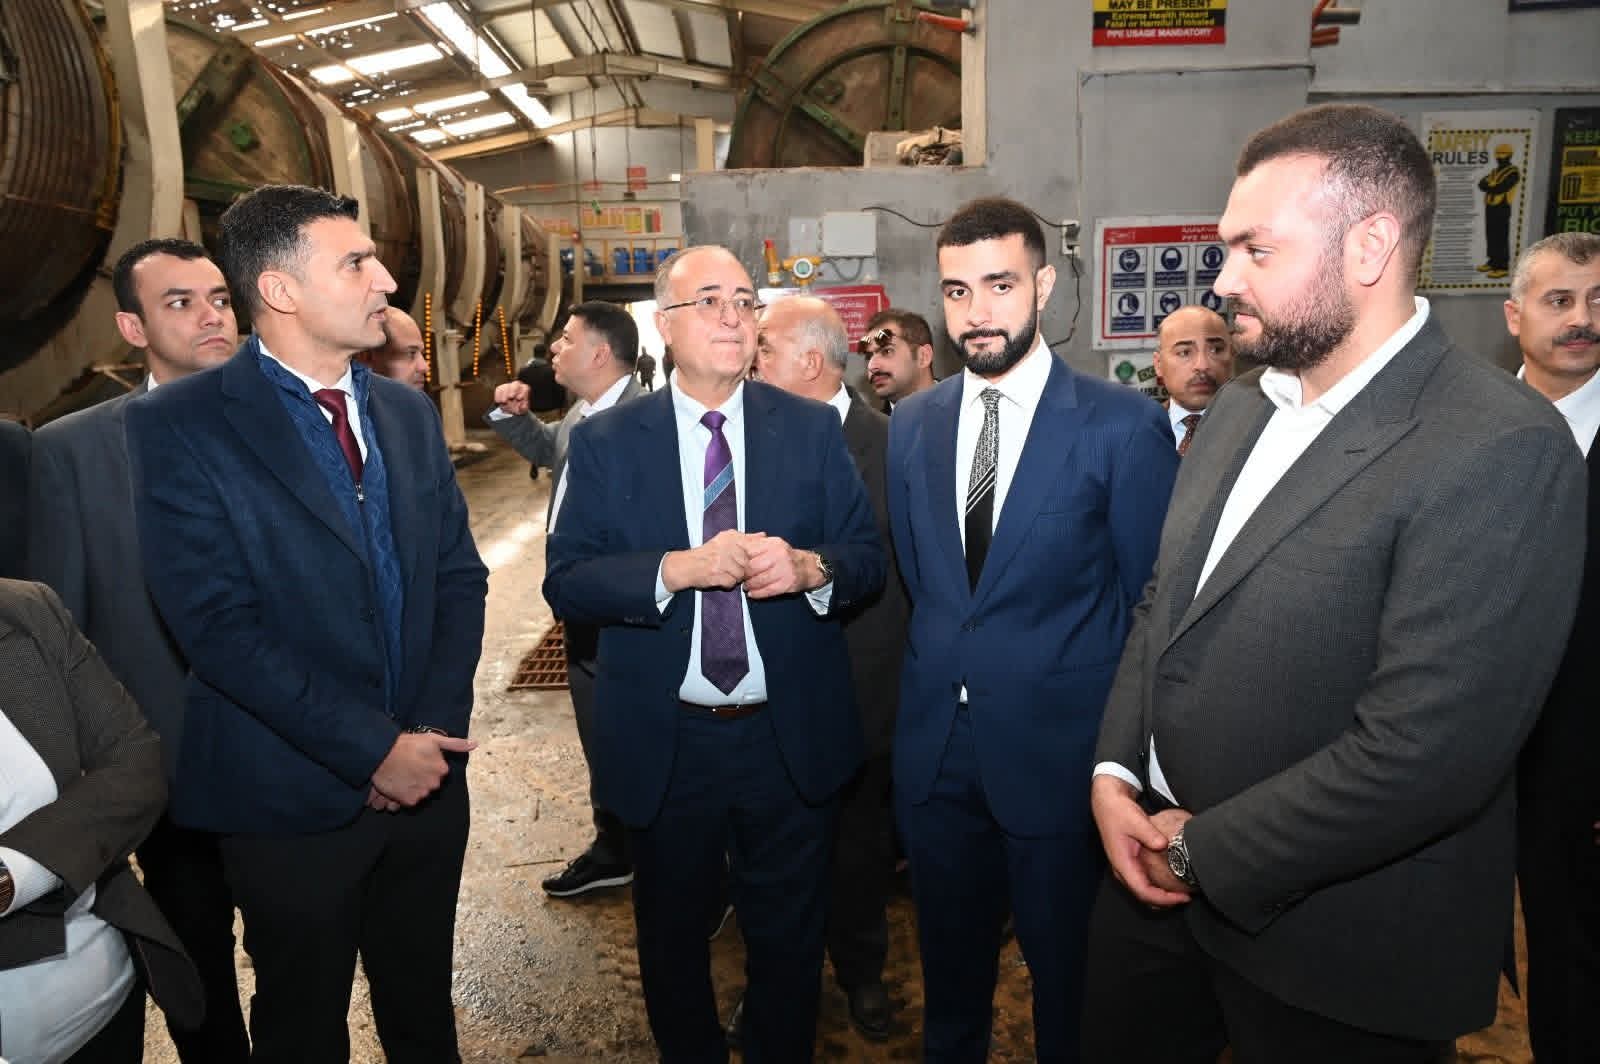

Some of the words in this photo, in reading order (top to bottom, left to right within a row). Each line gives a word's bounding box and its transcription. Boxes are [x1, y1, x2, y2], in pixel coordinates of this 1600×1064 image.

[1108, 0, 1132, 9] MAY
[1137, 0, 1153, 8] BE
[1157, 0, 1212, 8] PRESENT
[1106, 29, 1125, 38] PPE
[1126, 28, 1156, 38] USAGE
[1158, 28, 1212, 37] MANDATORY
[1432, 151, 1489, 165] RULES
